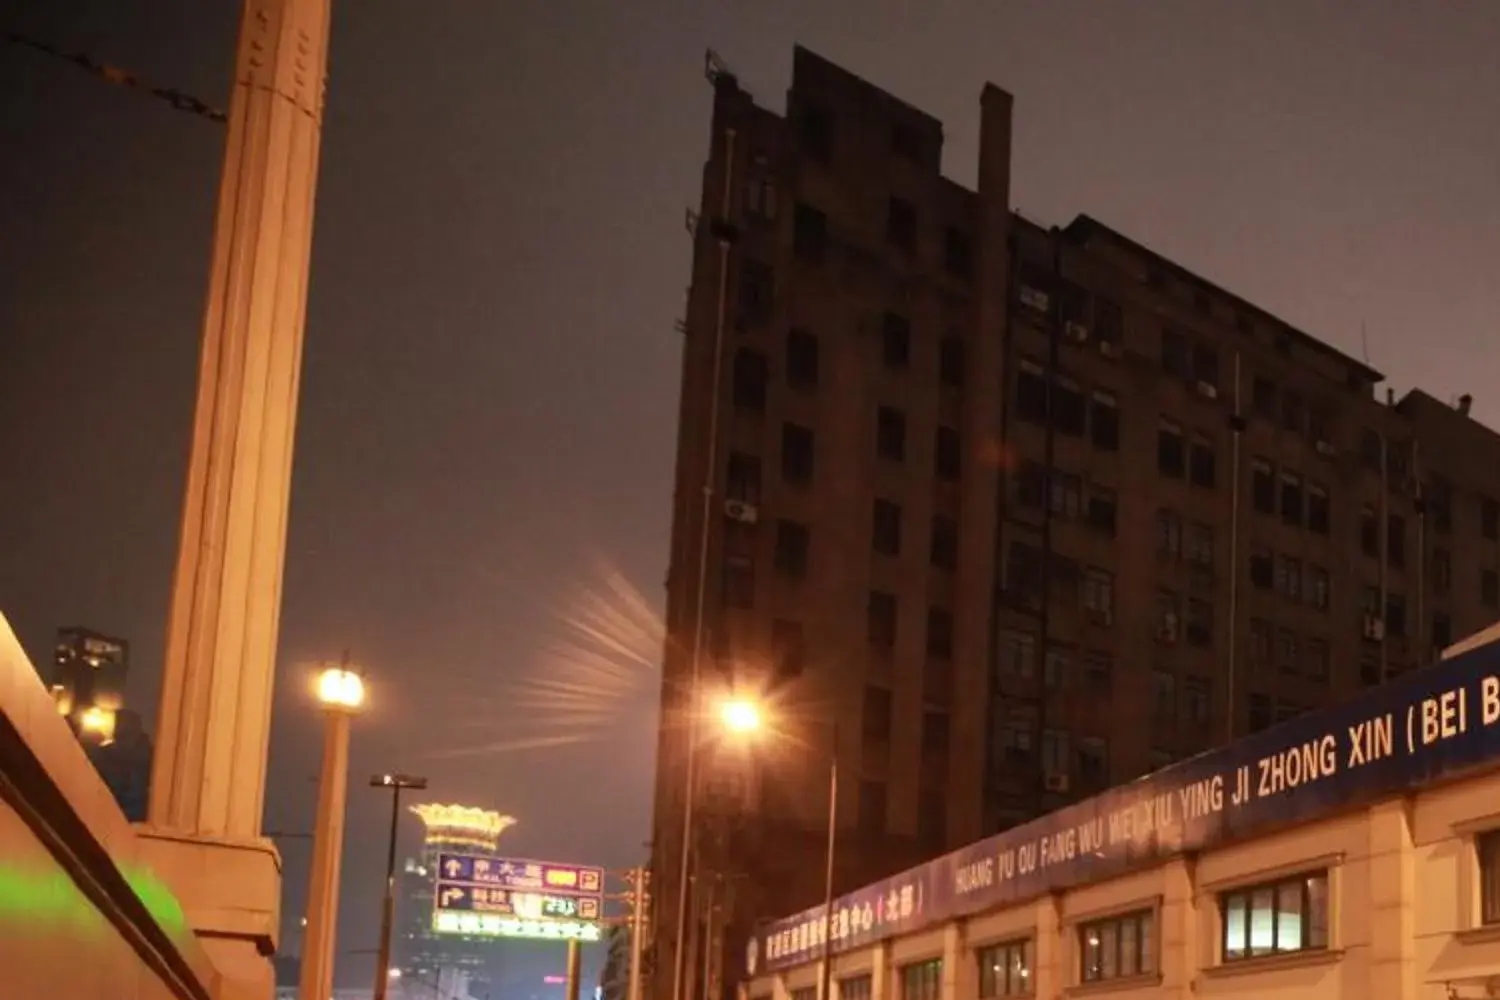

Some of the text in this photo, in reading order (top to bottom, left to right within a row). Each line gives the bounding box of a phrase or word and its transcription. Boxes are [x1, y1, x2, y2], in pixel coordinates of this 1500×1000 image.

[955, 857, 993, 895] HUANG
[1041, 828, 1076, 869] FANG
[1077, 816, 1103, 856] WU
[1180, 774, 1225, 820] YING
[1231, 765, 1250, 807] JI
[1257, 733, 1338, 798] ZHONG
[1347, 712, 1394, 769] XIN
